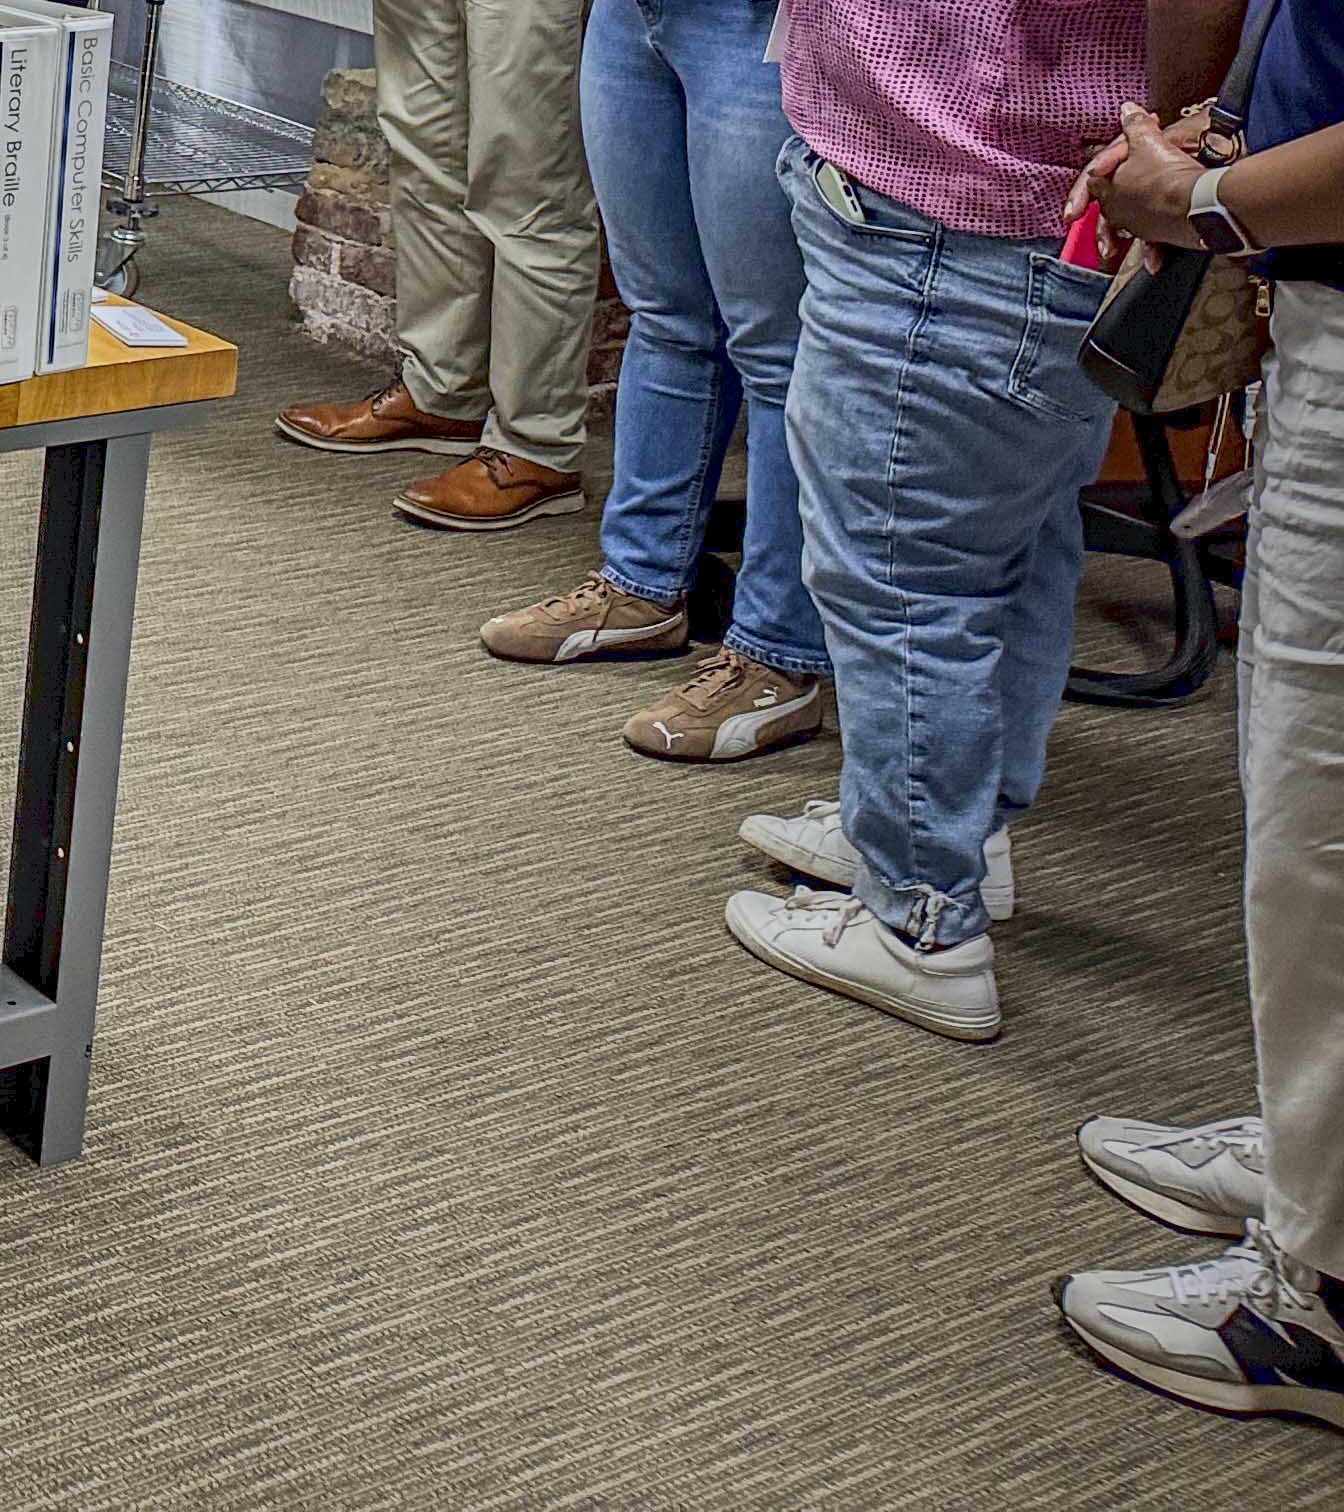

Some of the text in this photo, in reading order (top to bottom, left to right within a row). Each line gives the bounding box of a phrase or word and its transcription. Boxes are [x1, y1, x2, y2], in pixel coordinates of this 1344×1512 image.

[4, 48, 27, 133] Literary
[78, 37, 99, 94] Basic
[2, 140, 23, 208] Braille
[71, 100, 93, 214] Computer
[67, 218, 85, 264] Skills
